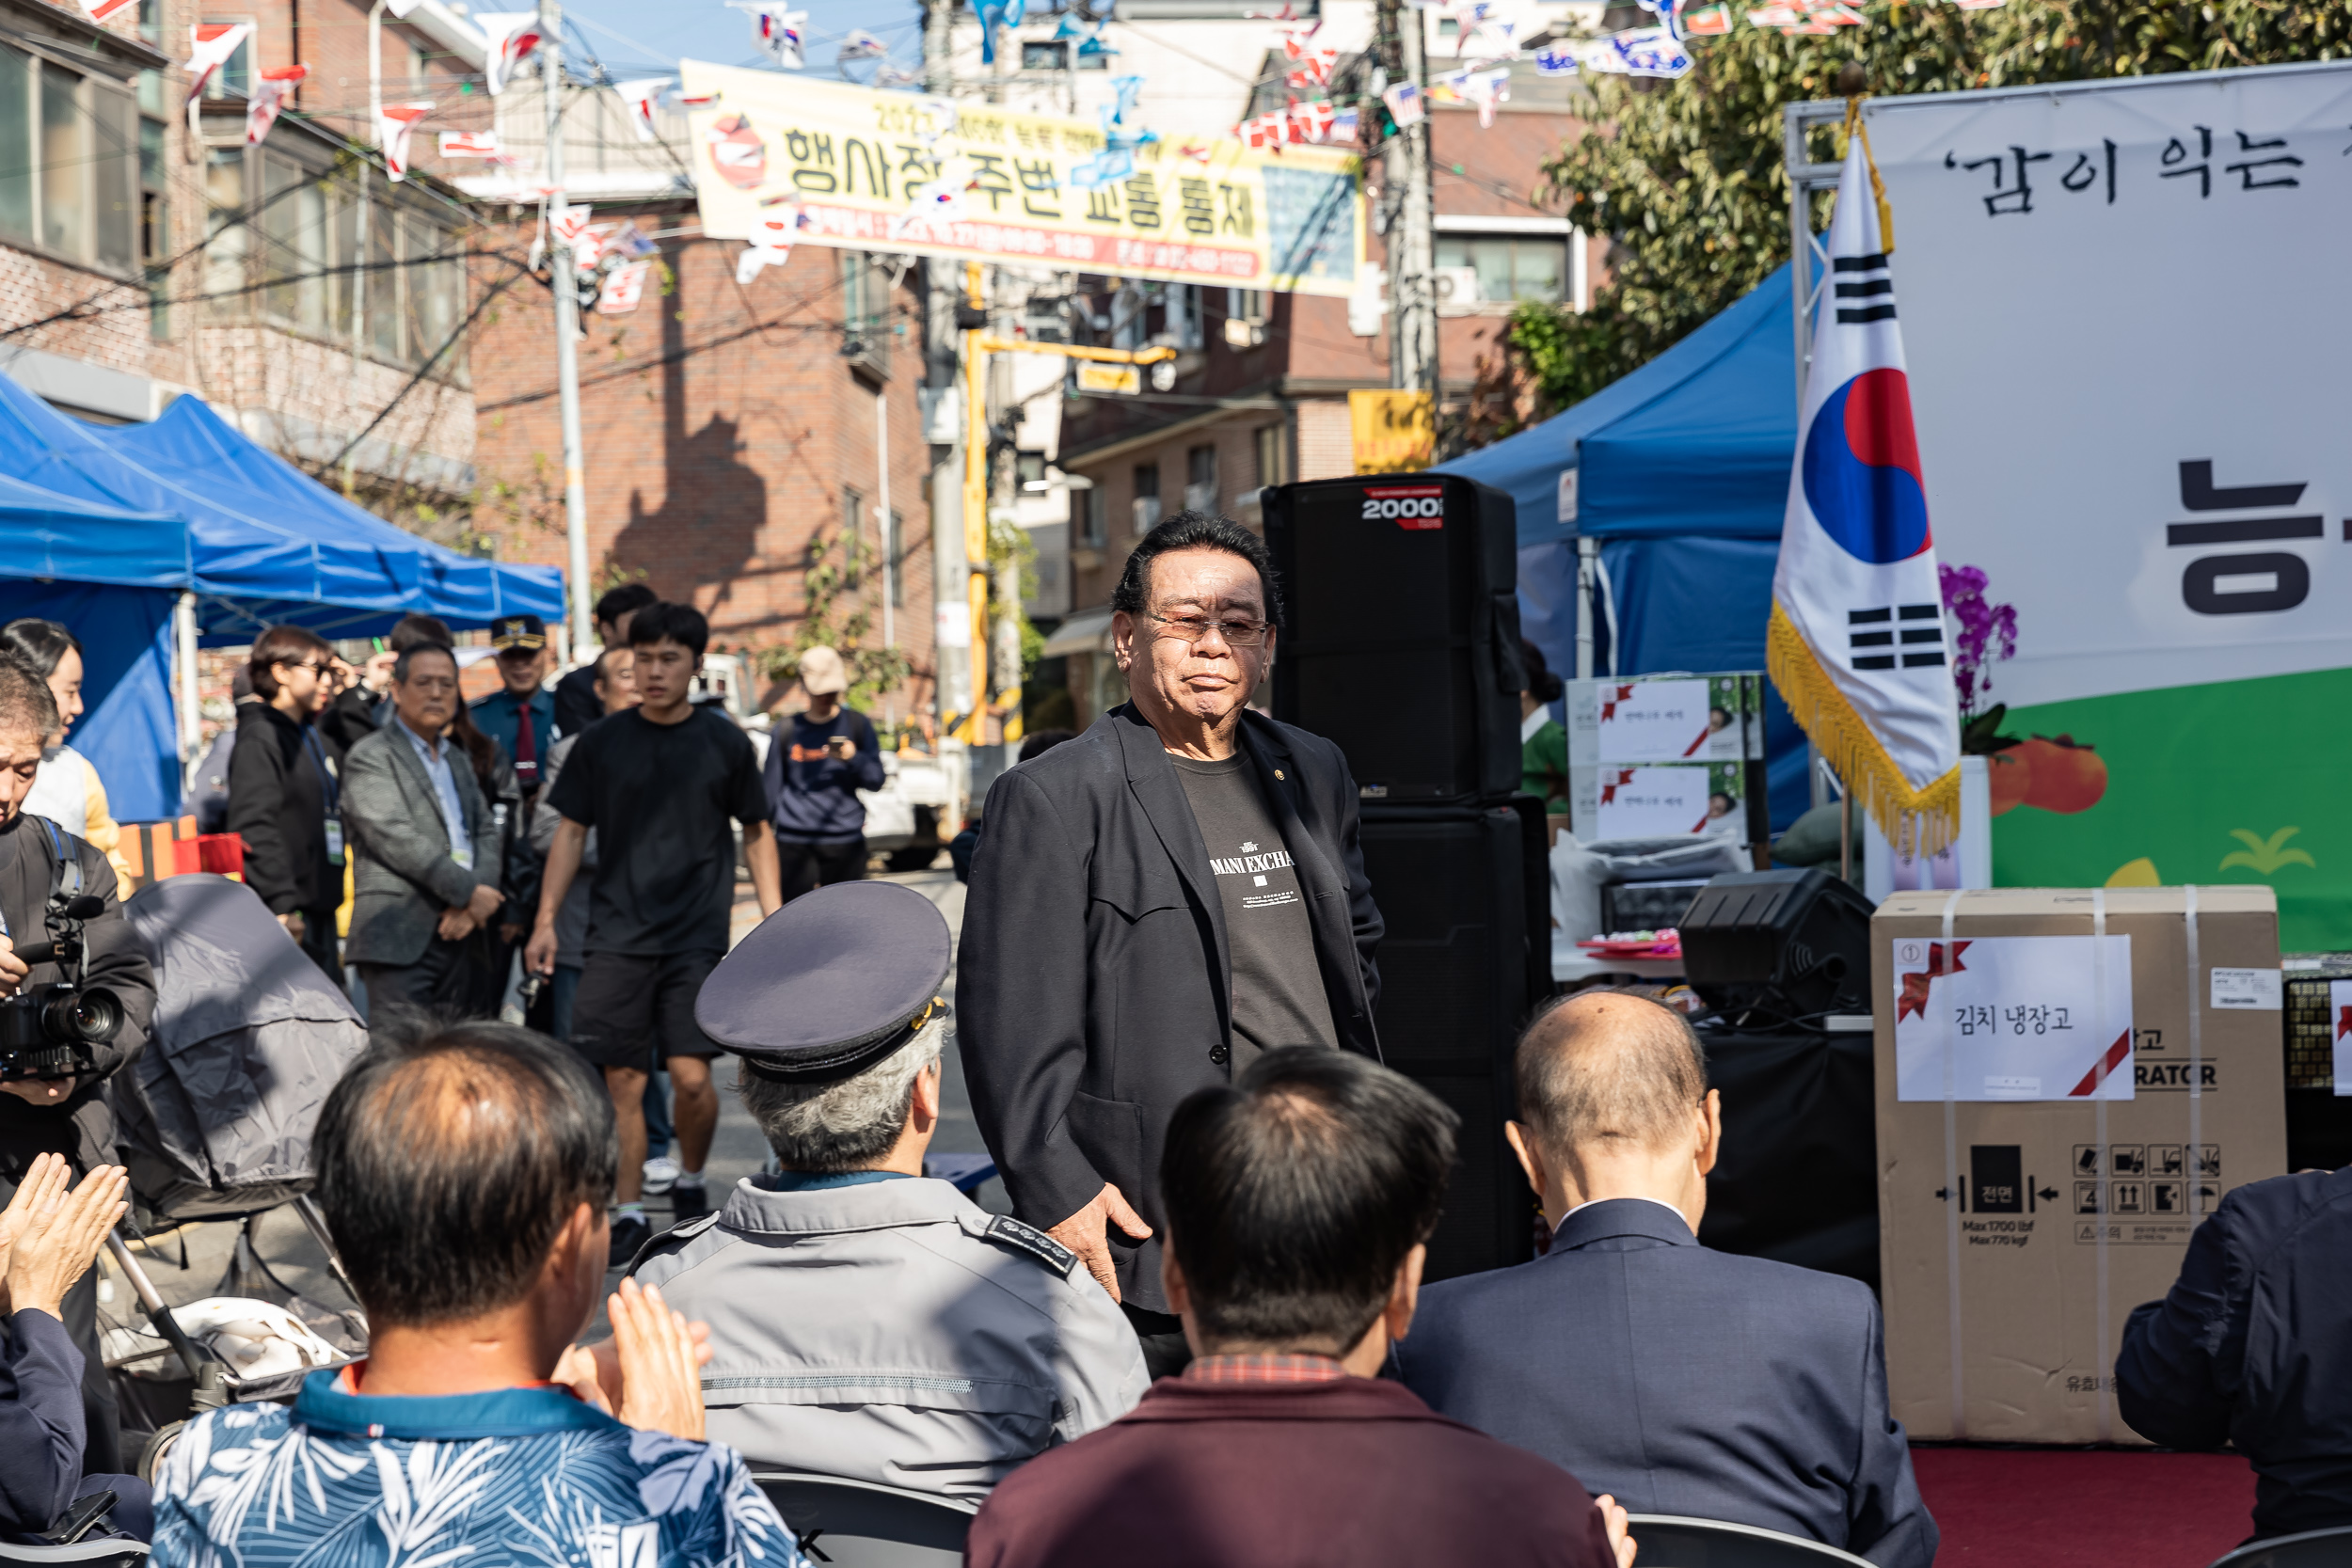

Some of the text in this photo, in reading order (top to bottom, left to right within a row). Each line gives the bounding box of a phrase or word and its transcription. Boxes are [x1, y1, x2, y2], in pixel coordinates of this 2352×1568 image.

[2159, 124, 2305, 200] 익는
[785, 129, 944, 203] 행사장
[967, 151, 1062, 218] 주변
[1086, 171, 1162, 229] 교통
[1181, 177, 1254, 239] 통제
[1361, 497, 1439, 520] 2000
[1244, 850, 1295, 873] EXCHA
[1955, 1004, 2074, 1037] 김치 냉장고
[1981, 1184, 2013, 1205] 전면
